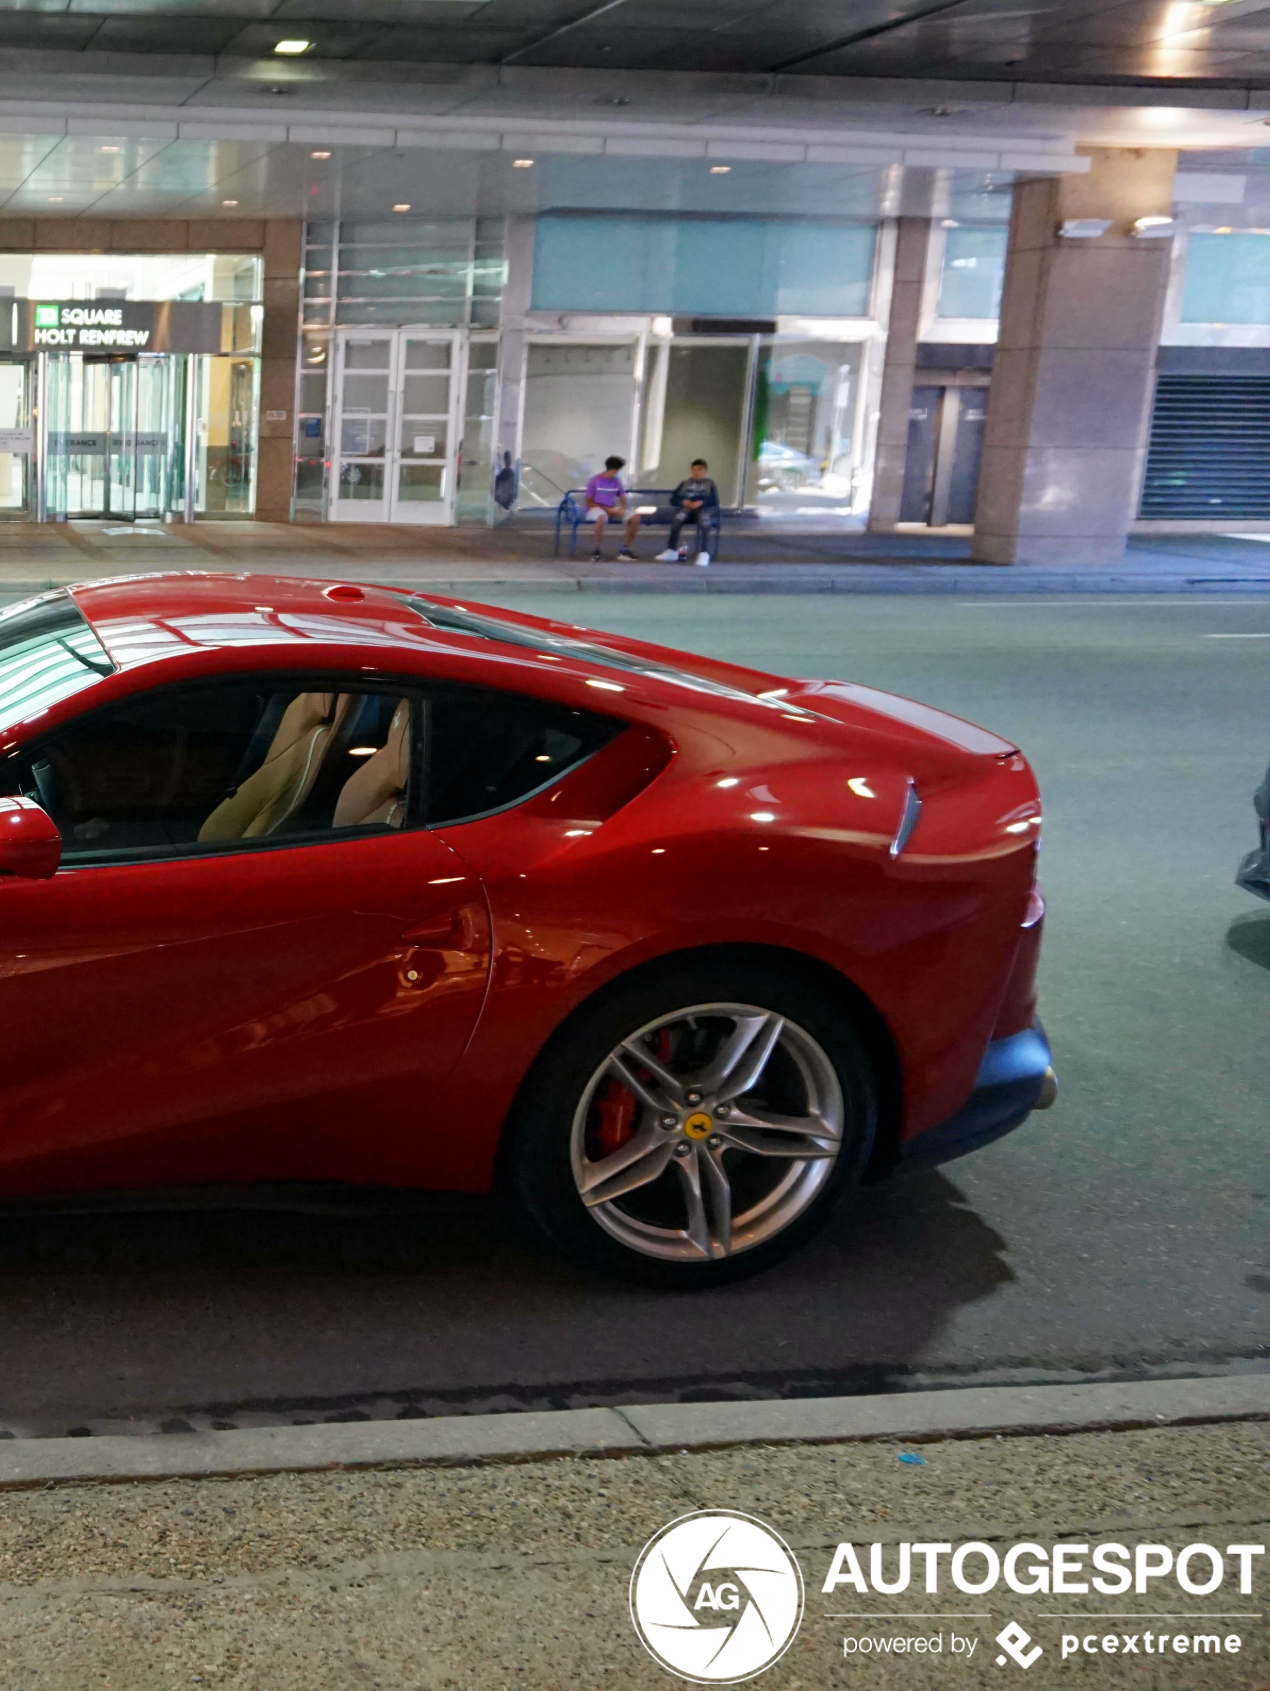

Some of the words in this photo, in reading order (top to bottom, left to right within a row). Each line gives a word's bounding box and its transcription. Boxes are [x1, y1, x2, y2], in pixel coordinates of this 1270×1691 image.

[61, 309, 122, 325] SQUARE
[34, 329, 75, 345] HOLT
[80, 330, 150, 346] RENFREW
